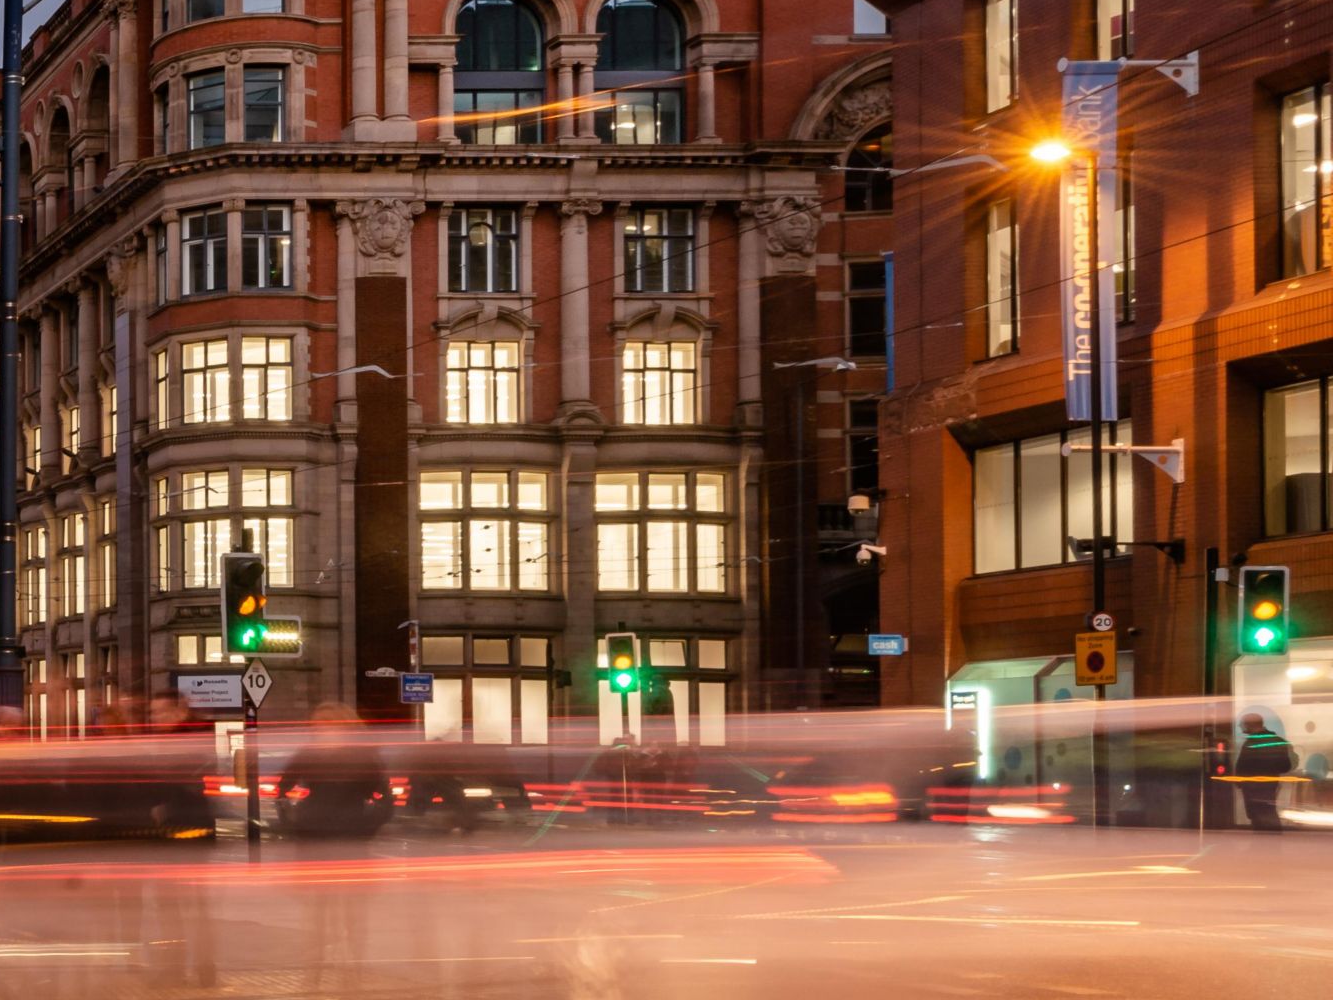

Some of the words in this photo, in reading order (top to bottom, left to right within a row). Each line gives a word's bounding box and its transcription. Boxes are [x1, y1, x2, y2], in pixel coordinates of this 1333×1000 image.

[1068, 334, 1090, 381] The
[1096, 618, 1111, 627] 20
[873, 640, 898, 650] cash
[247, 674, 266, 689] 10
